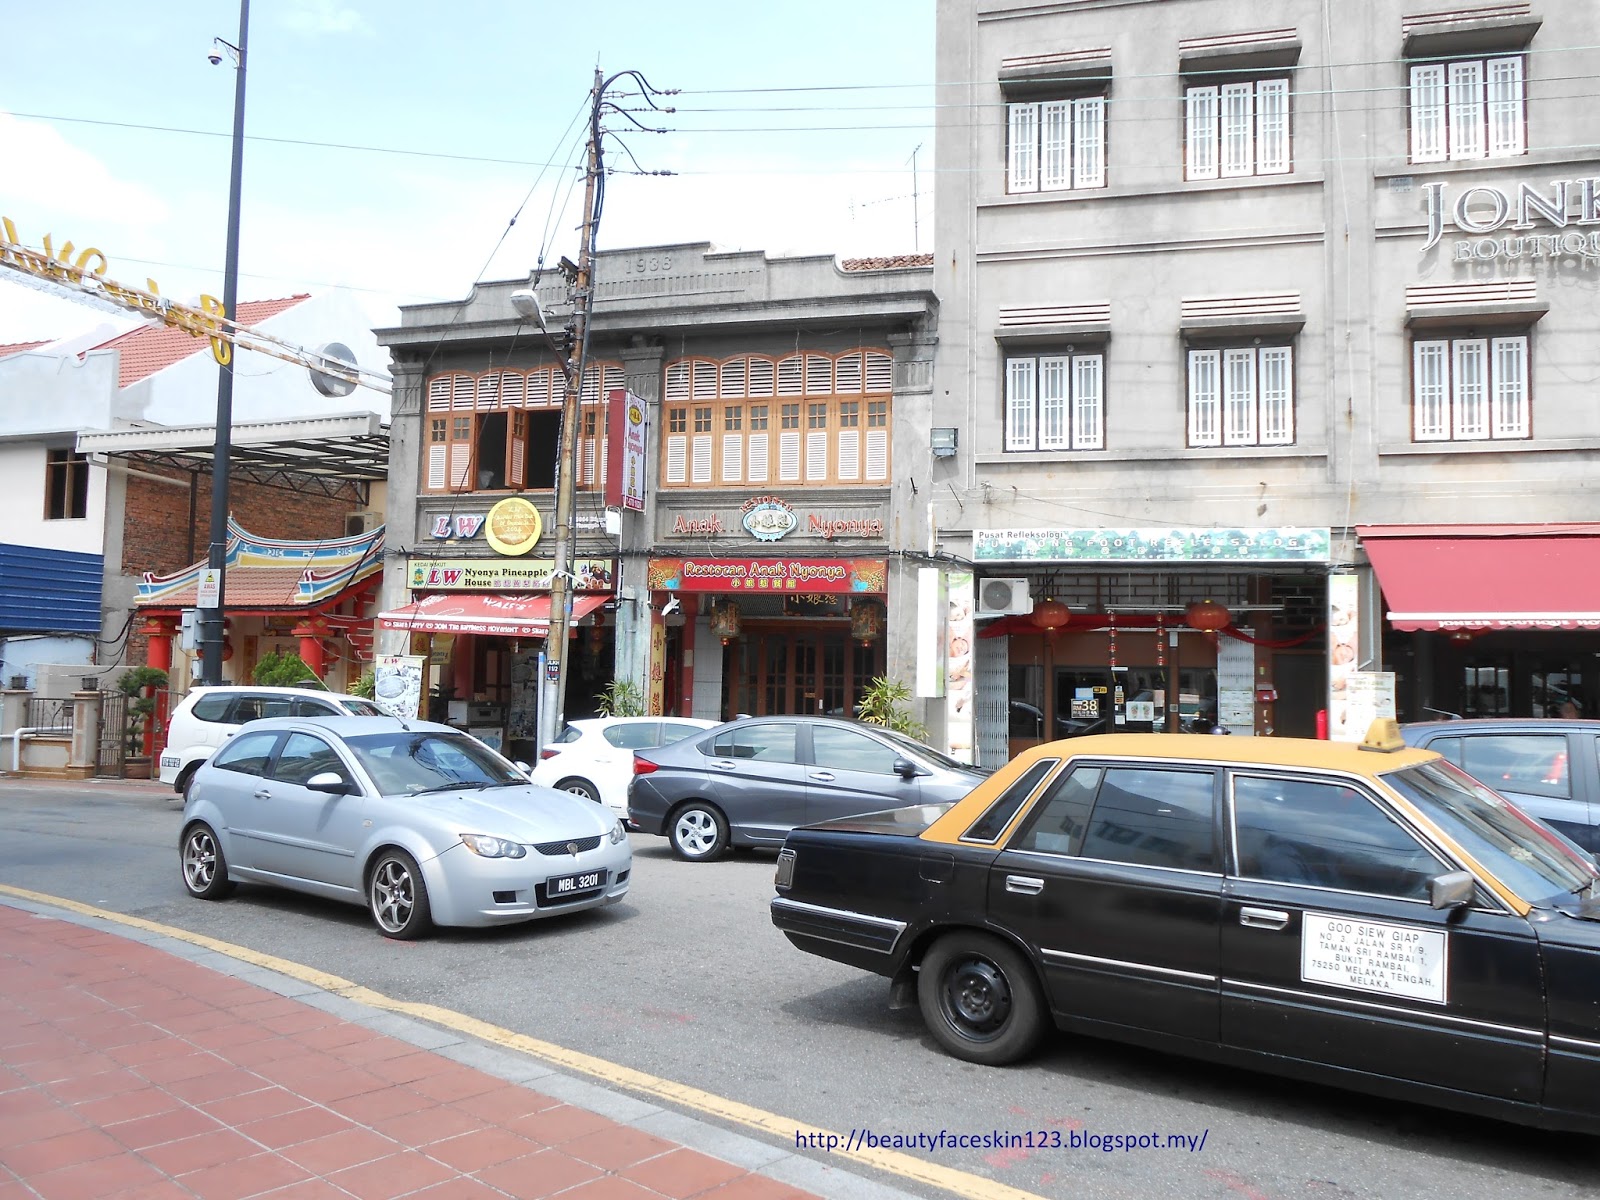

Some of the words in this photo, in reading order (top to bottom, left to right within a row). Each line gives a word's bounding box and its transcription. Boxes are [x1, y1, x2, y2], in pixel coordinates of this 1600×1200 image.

[673, 514, 723, 533] Anak
[808, 514, 884, 539] Nyonya
[979, 531, 1003, 539] Pusat
[1007, 530, 1063, 539] Refleksologi
[1087, 539, 1136, 547] FOOT
[465, 568, 499, 577] Nyonya
[502, 568, 548, 578] Pineapple
[684, 562, 746, 578] Restoran
[750, 562, 787, 578] Anak
[789, 563, 846, 581] Nyonya
[465, 578, 492, 586] House
[1438, 619, 1493, 628] JONKER
[1498, 619, 1571, 627] BOUTIQUE
[1082, 701, 1097, 711] 38
[558, 877, 577, 892] MBL
[579, 873, 599, 888] 3201
[1328, 921, 1352, 934] GOO
[1358, 926, 1385, 939] SIEW
[1392, 931, 1419, 943] GIAP
[1319, 932, 1335, 941] NO.
[1353, 937, 1385, 949] JALAN
[1390, 942, 1403, 952] SR
[1320, 942, 1351, 954] TAMAN
[1356, 947, 1372, 957] SRI
[1376, 950, 1415, 964] RAMBAI
[1335, 953, 1363, 965] BUKIT
[1312, 959, 1340, 971] 75250
[1345, 965, 1385, 979] MELAKA
